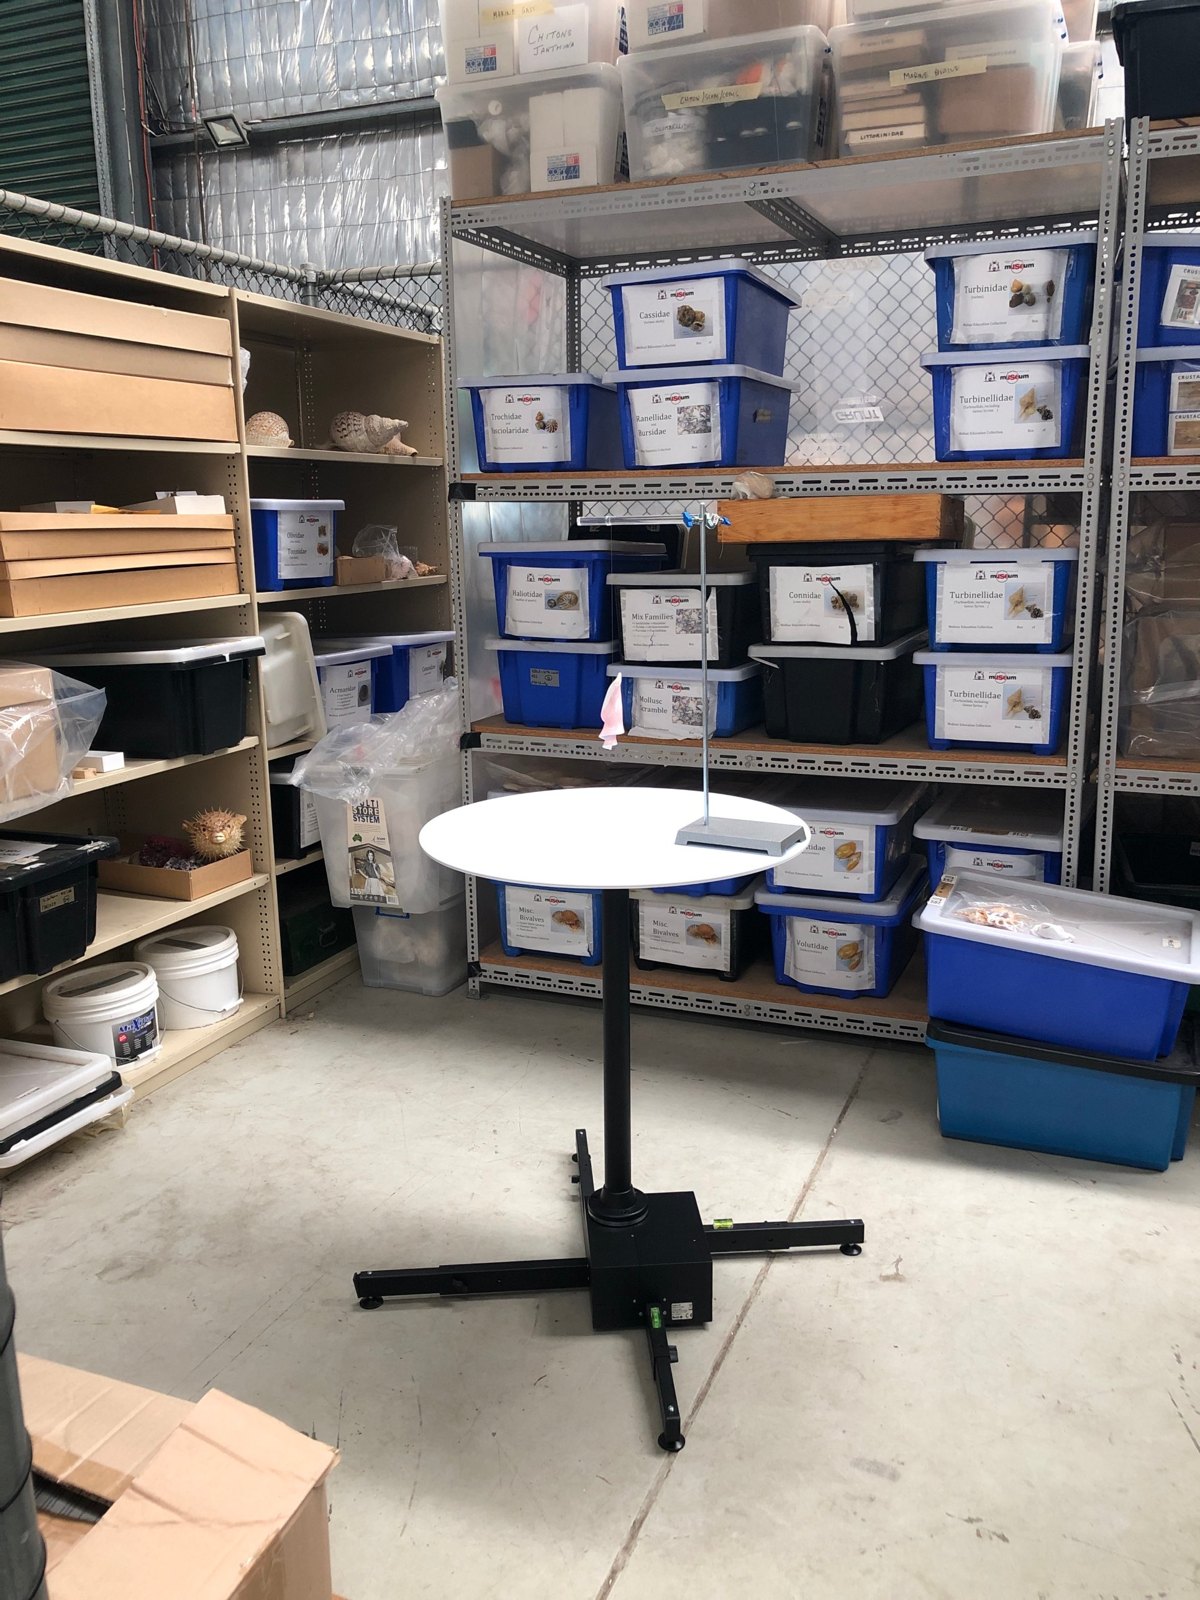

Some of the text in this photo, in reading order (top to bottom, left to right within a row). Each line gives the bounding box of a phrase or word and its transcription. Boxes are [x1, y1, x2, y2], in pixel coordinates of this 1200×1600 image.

[964, 284, 1008, 294] Turbinidae
[639, 310, 670, 319] Cassidae
[960, 394, 1013, 404] Turbinellidae
[636, 413, 672, 422] Ranellidae
[637, 428, 666, 437] Bursidae
[512, 590, 542, 598] Haliotidae
[788, 591, 821, 599] Connidae
[949, 591, 1003, 599] Turbinellidae
[948, 690, 1001, 699] Turbinellidae
[640, 696, 663, 704] Mollusc
[640, 705, 668, 714] Scramble
[353, 806, 379, 816] STORE
[353, 815, 380, 824] SYSTEM
[805, 843, 826, 851] utidae
[520, 914, 544, 923] Bivalves
[653, 928, 679, 937] Bivalves
[796, 939, 829, 951] Volutidae
